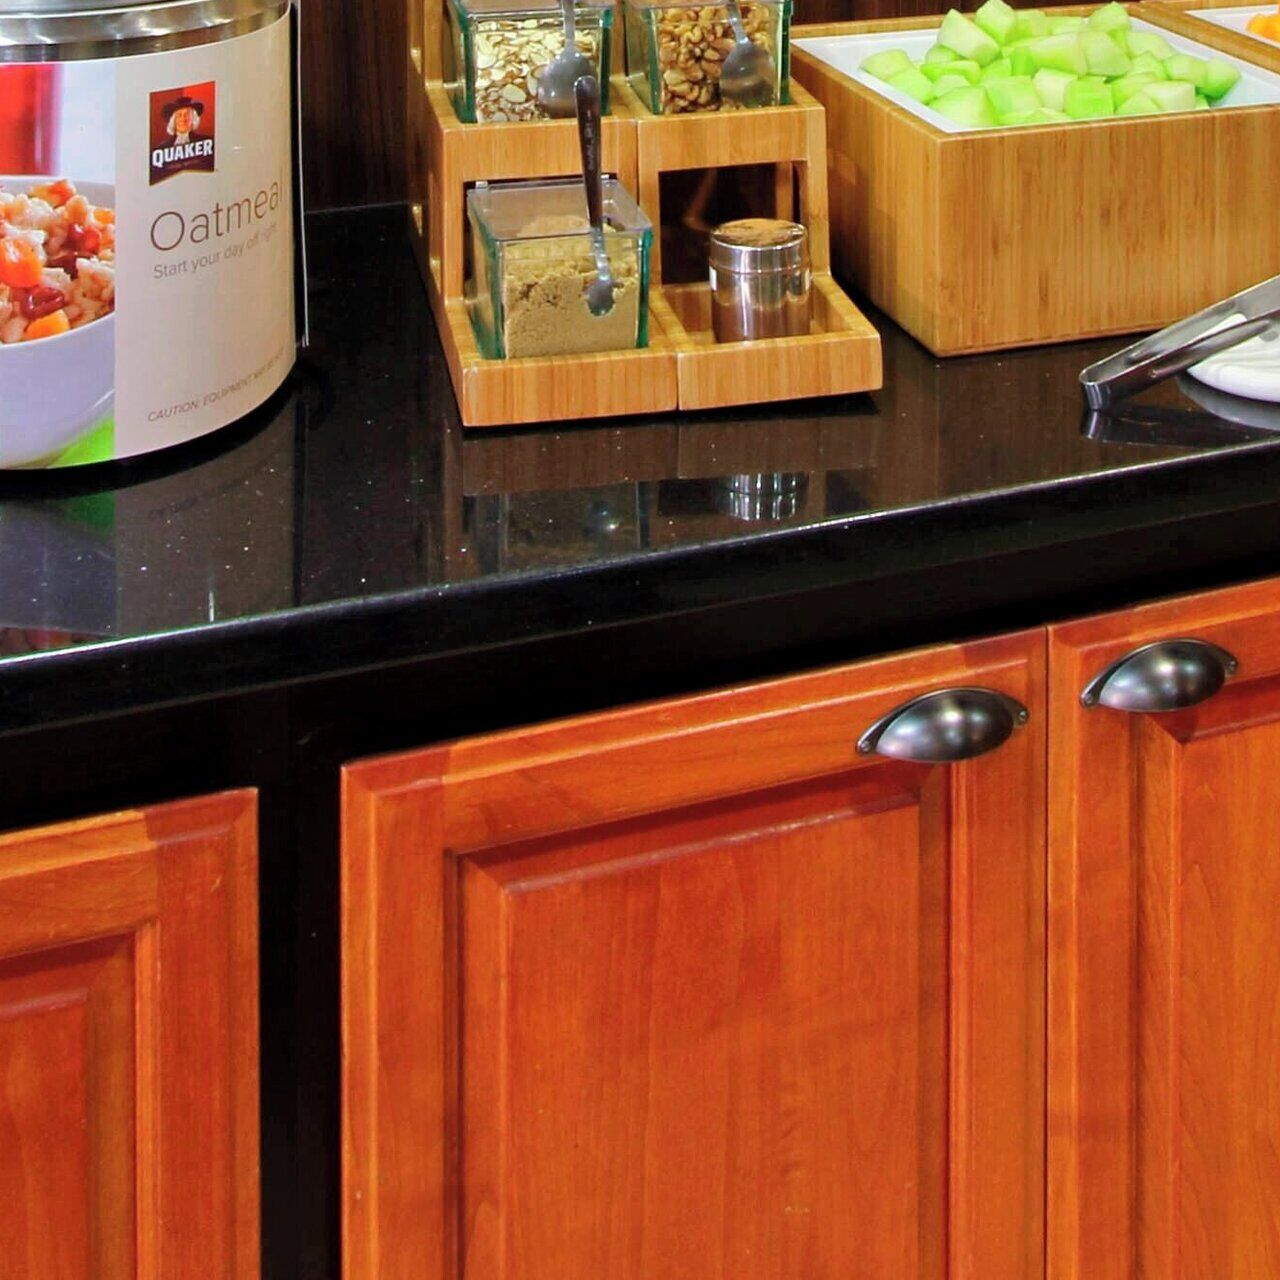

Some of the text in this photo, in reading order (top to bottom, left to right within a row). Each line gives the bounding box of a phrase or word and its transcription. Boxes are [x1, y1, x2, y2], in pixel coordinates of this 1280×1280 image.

[152, 138, 213, 168] QUAKER
[150, 170, 283, 251] Oatmeal
[153, 263, 187, 279] Start
[191, 252, 221, 273] your
[224, 240, 245, 260] day
